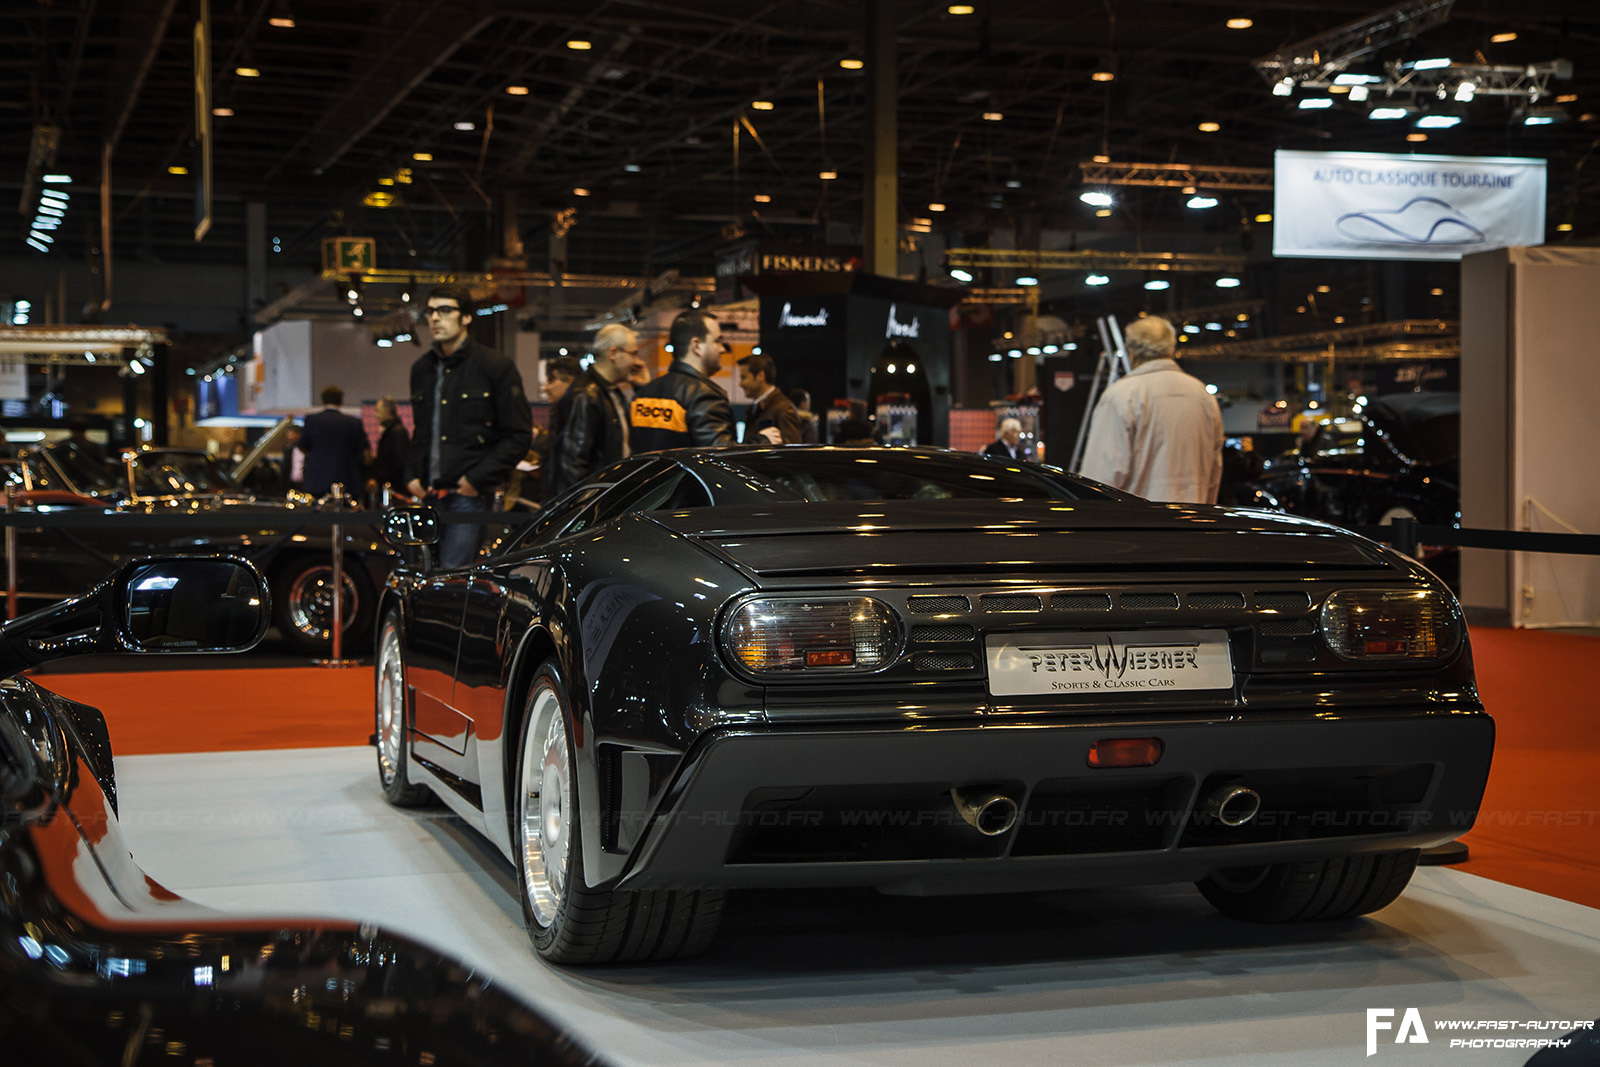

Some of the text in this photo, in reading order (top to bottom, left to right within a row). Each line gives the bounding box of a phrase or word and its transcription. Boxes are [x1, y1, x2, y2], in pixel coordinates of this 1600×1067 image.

[1313, 170, 1515, 190] AUTO CLASSIQUE TOURAINE
[762, 254, 842, 273] FISKENS
[1026, 651, 1095, 673] PETER
[1051, 677, 1176, 691] SPORTS & CLASSIC CARS
